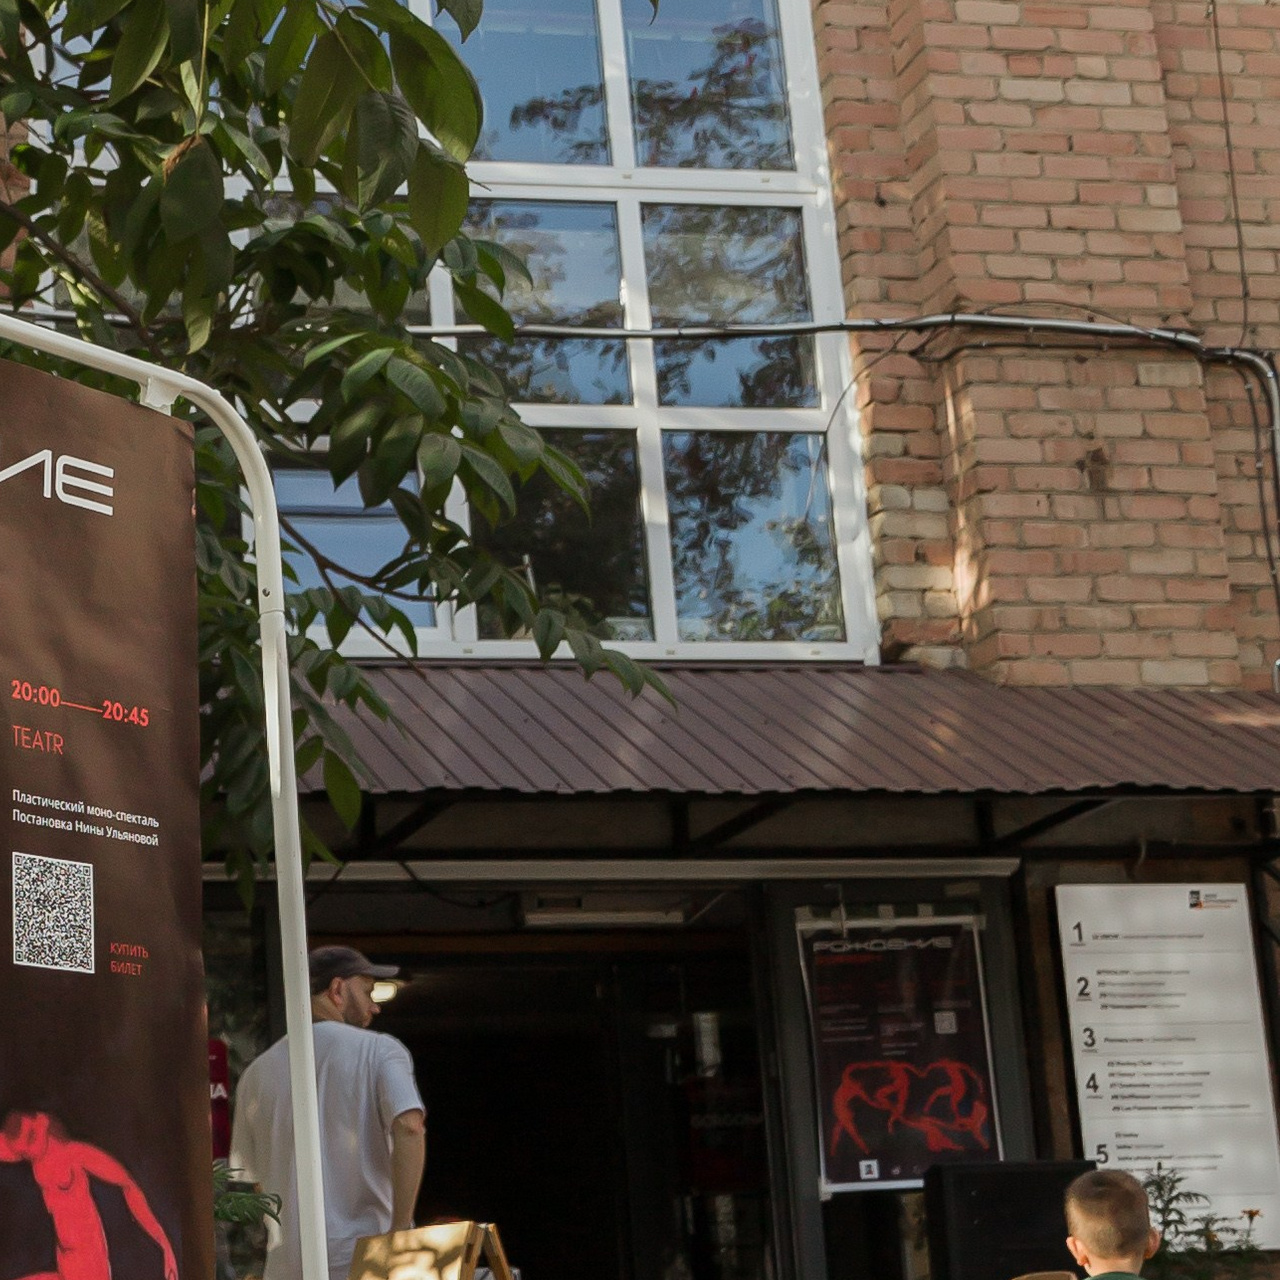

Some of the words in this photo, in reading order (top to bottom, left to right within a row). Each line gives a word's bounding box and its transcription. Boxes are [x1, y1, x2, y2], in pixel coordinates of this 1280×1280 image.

[12, 725, 64, 755] TEATR
[12, 788, 85, 814] Пластический
[12, 808, 73, 832] Постановка
[75, 820, 104, 837] Нины
[105, 825, 159, 847] Ульяновой
[1073, 921, 1083, 942] 1
[110, 942, 149, 959] КУПИТЬ
[110, 960, 142, 976] БИЛЕТ
[1077, 976, 1091, 997] 2
[1082, 1027, 1096, 1047] 3
[1085, 1072, 1099, 1093] 4
[1096, 1144, 1109, 1164] 5
